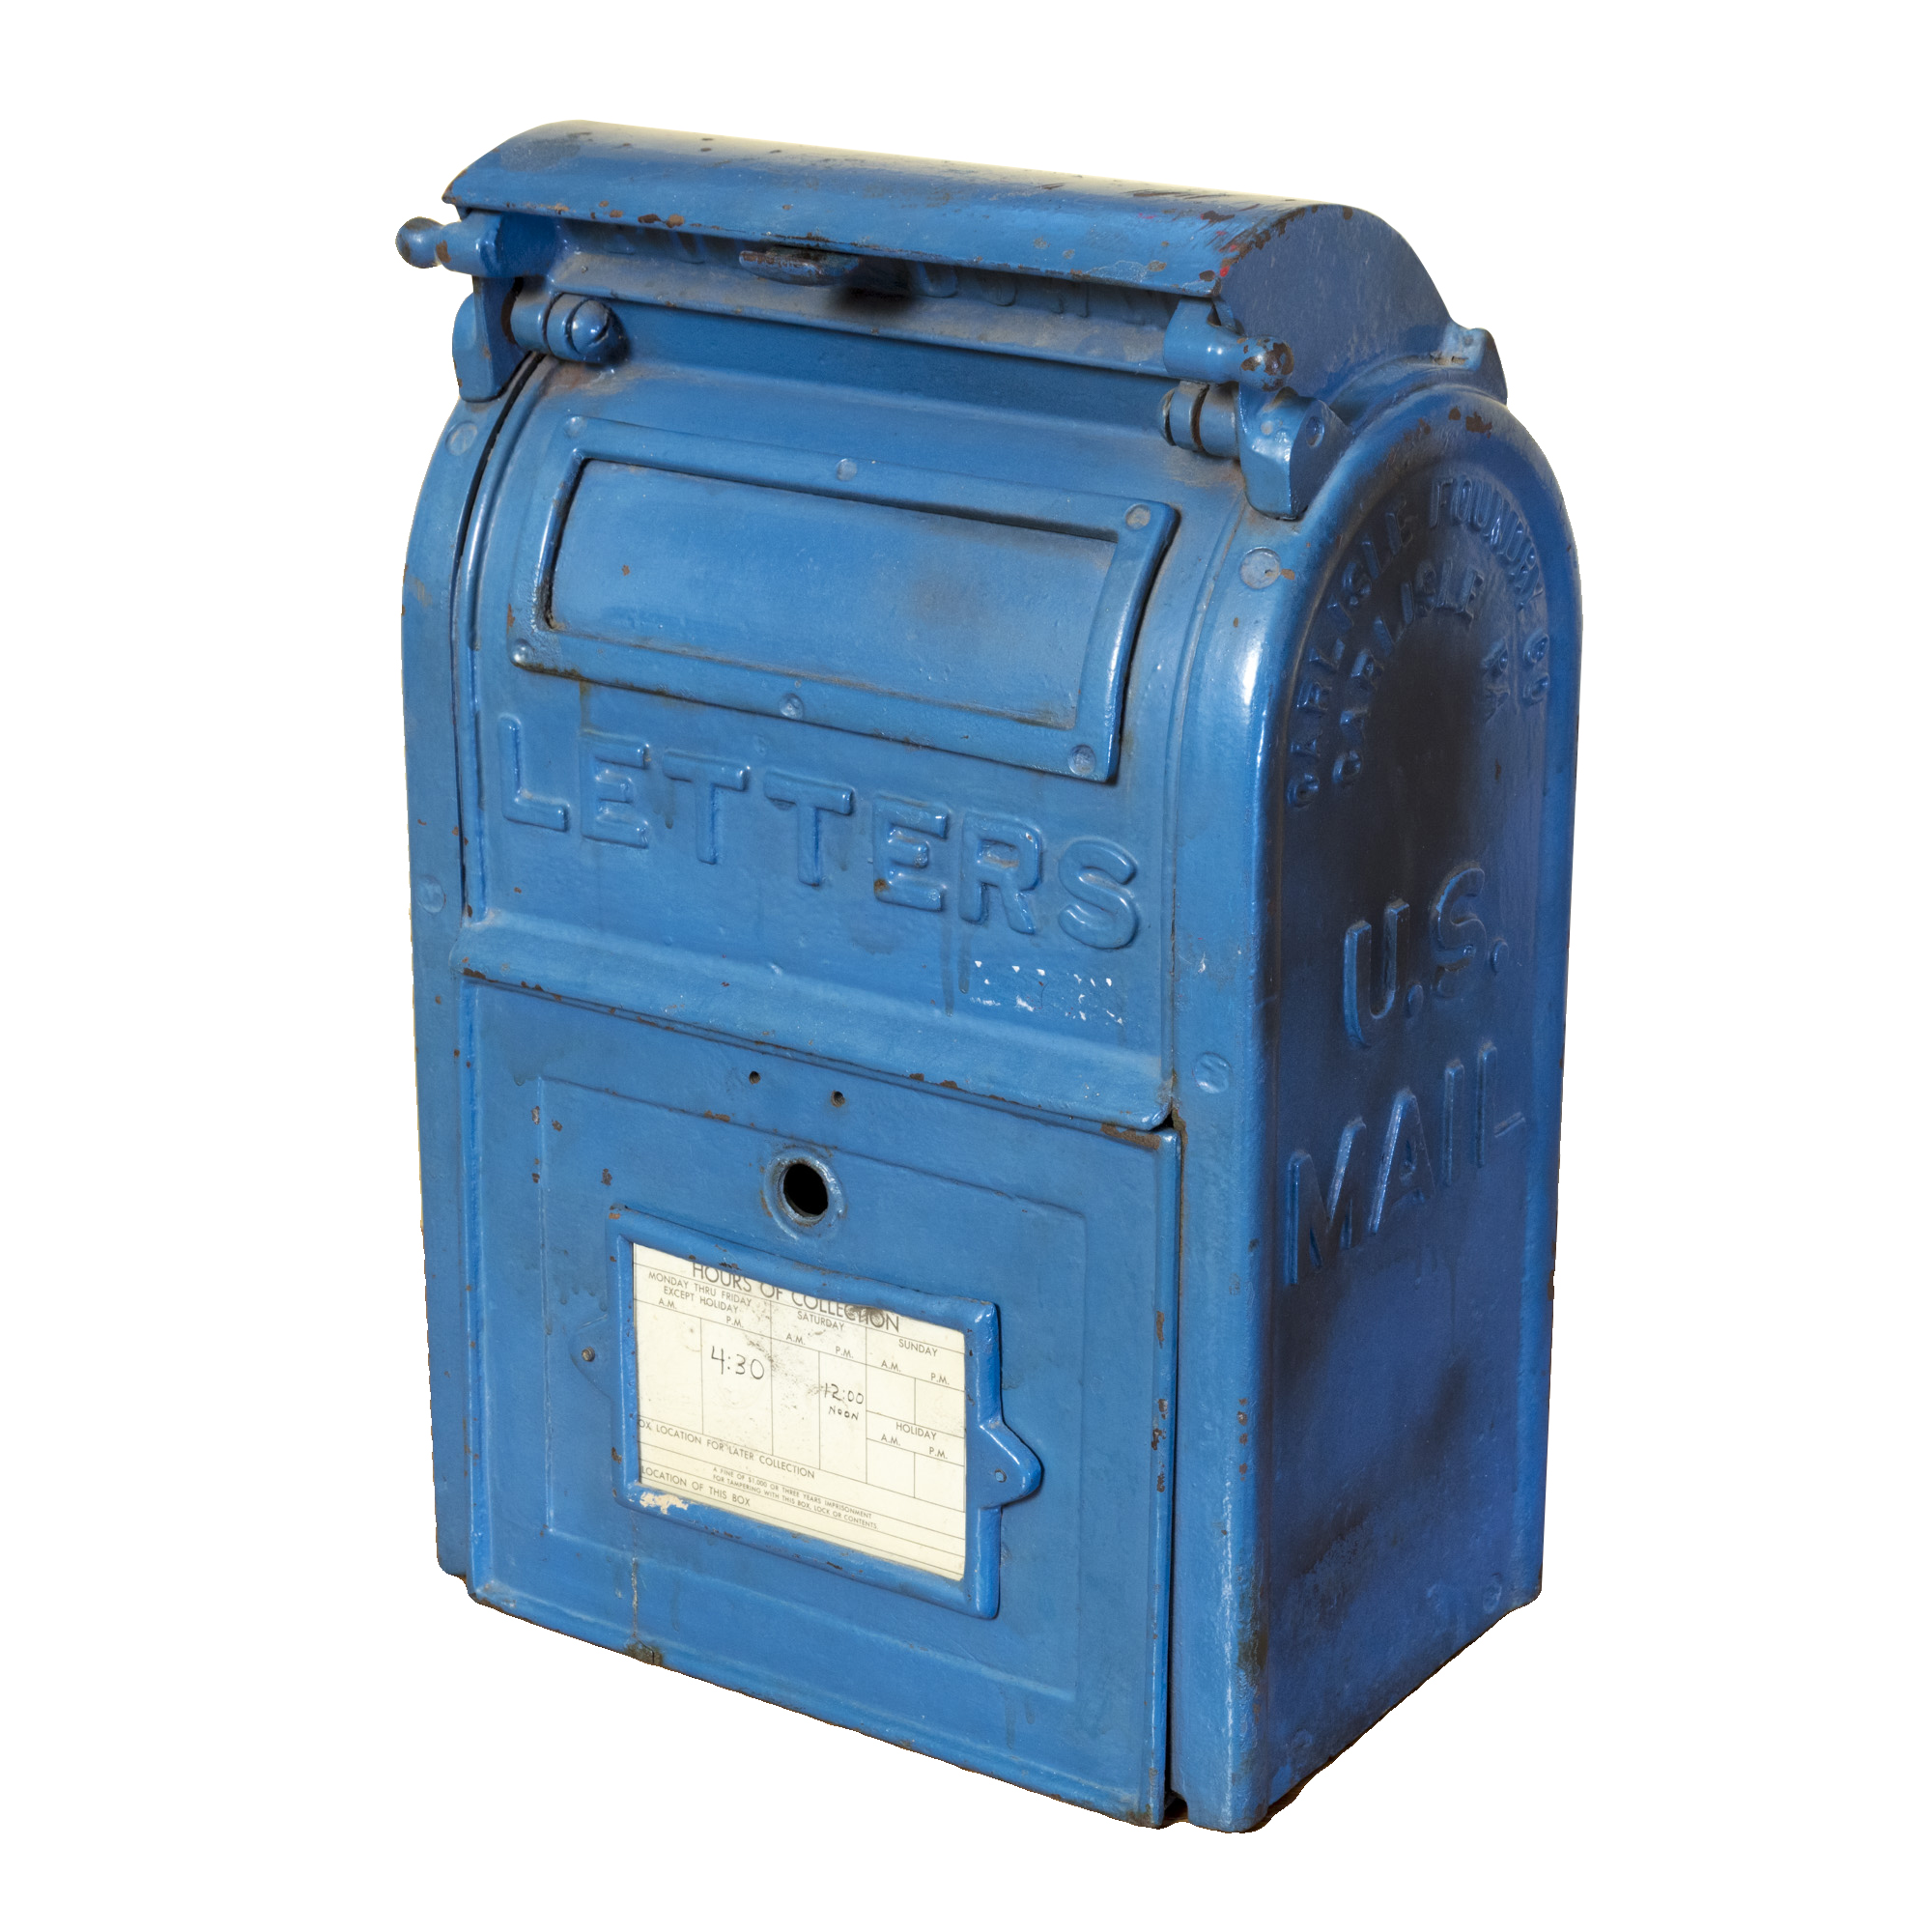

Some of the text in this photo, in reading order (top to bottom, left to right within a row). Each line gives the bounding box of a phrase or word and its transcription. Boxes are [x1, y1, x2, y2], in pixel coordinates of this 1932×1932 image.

[1429, 472, 1545, 611] FOUNDRY
[497, 712, 1139, 951] LETTERS
[1342, 860, 1510, 1049] U.S.
[1285, 1041, 1526, 1286] MAIL
[648, 1270, 753, 1307] MONDAY THRU FRIDAY
[664, 1285, 739, 1314] EXCEPT HOLIDAY
[692, 1262, 900, 1333] HOURS OF COLLECTION
[658, 1297, 677, 1310] A.M.
[725, 1315, 744, 1329] P.M.
[797, 1310, 845, 1332] SATURDAY
[785, 1332, 806, 1346] A.M.
[898, 1338, 938, 1357] SUNDAY
[711, 1345, 765, 1380] 4:30
[835, 1346, 854, 1359] P.M.
[881, 1359, 901, 1373] A.M.
[930, 1372, 950, 1385] P.M.
[823, 1382, 865, 1405] 12:00
[828, 1406, 860, 1421] NOON
[880, 1434, 901, 1447] A.M.
[895, 1421, 937, 1441] HOLIDAY
[638, 1418, 816, 1480] OX LOCATION FOR LATER COLLECTION
[928, 1446, 949, 1460] P.M.
[641, 1465, 751, 1507] LOCATION OF THIS BOX
[720, 1468, 734, 1478] FINE
[769, 1483, 779, 1492] OR
[781, 1487, 800, 1498] THREE
[803, 1493, 822, 1504] YEARS
[824, 1499, 872, 1520] IMPRISONMENT
[713, 1474, 724, 1483] FOR
[726, 1478, 761, 1494] TAMPERING
[763, 1490, 780, 1499] WITH
[781, 1494, 796, 1504] THIS
[797, 1499, 812, 1511] BOX,
[813, 1505, 831, 1516] LOCK
[843, 1514, 879, 1530] CONTENTS.
